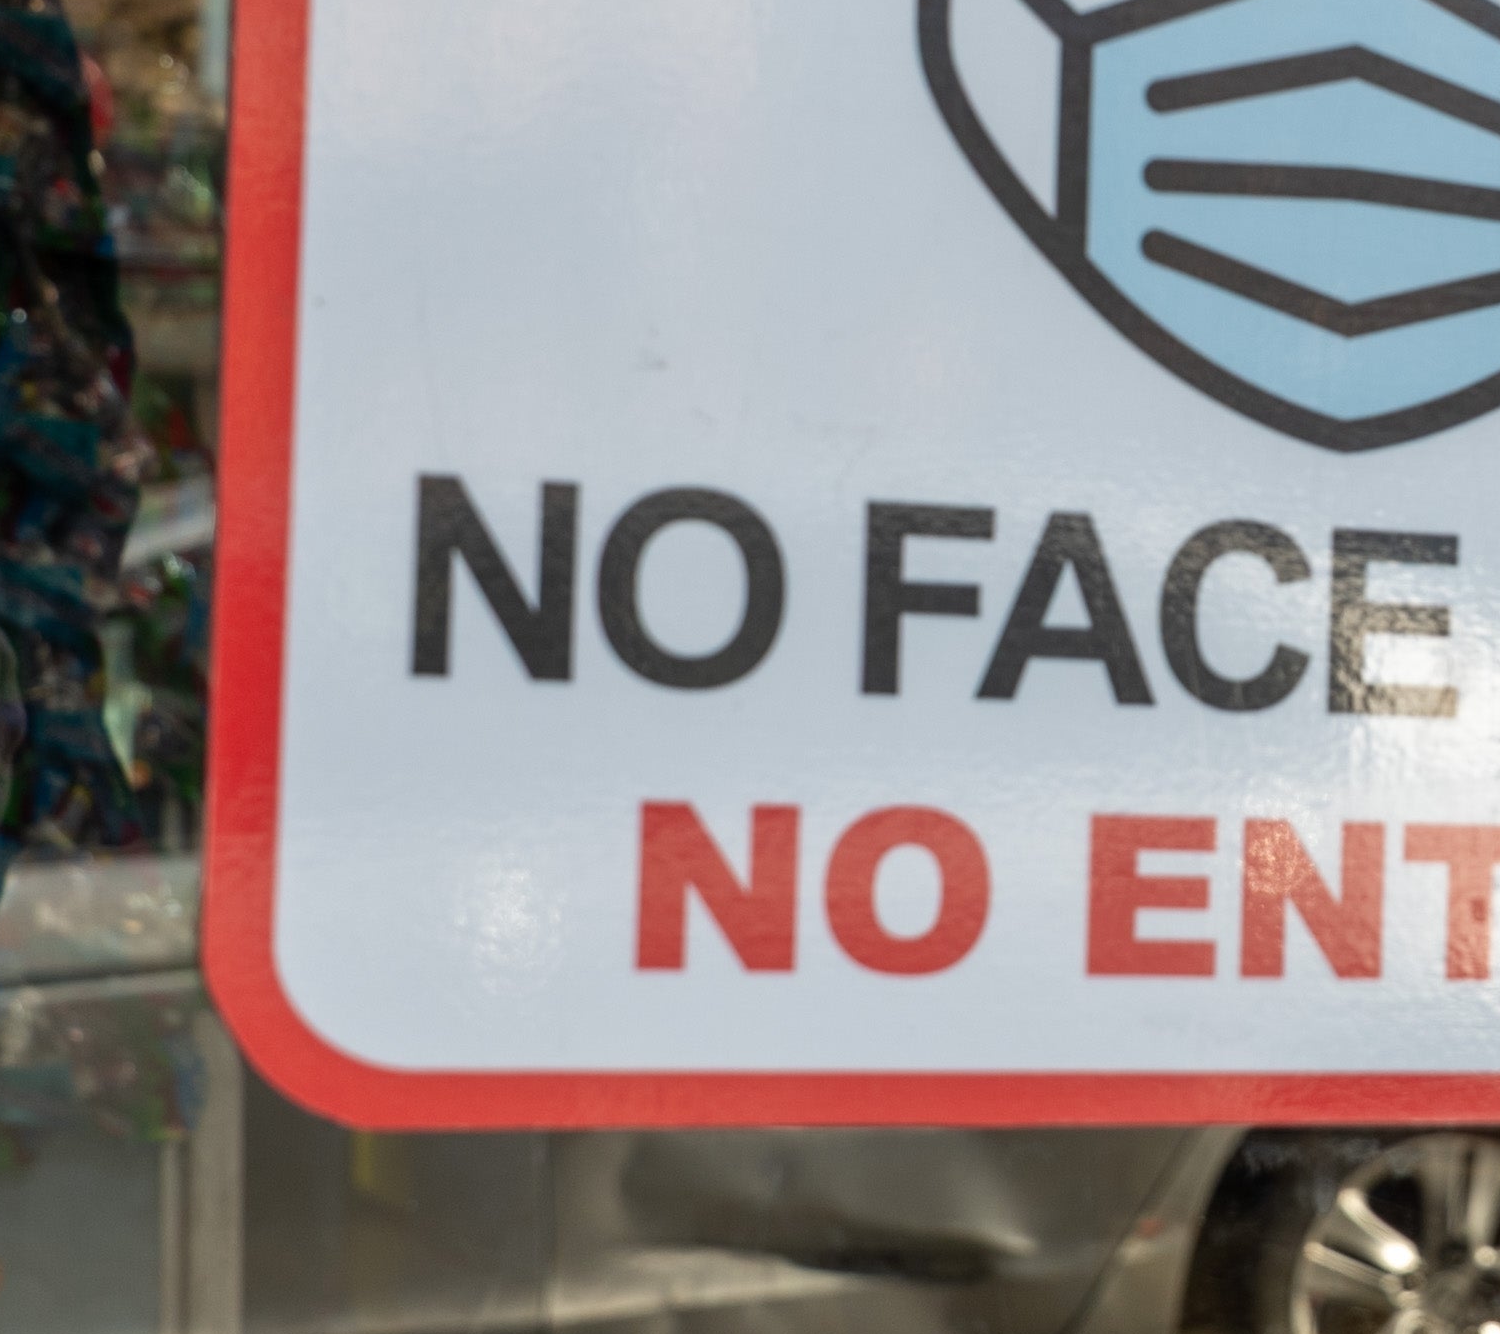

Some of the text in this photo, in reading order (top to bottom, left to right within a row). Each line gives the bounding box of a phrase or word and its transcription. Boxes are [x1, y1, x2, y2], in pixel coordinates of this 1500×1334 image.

[408, 473, 790, 691] NO
[860, 500, 1460, 719] FACE
[633, 800, 992, 977] NO
